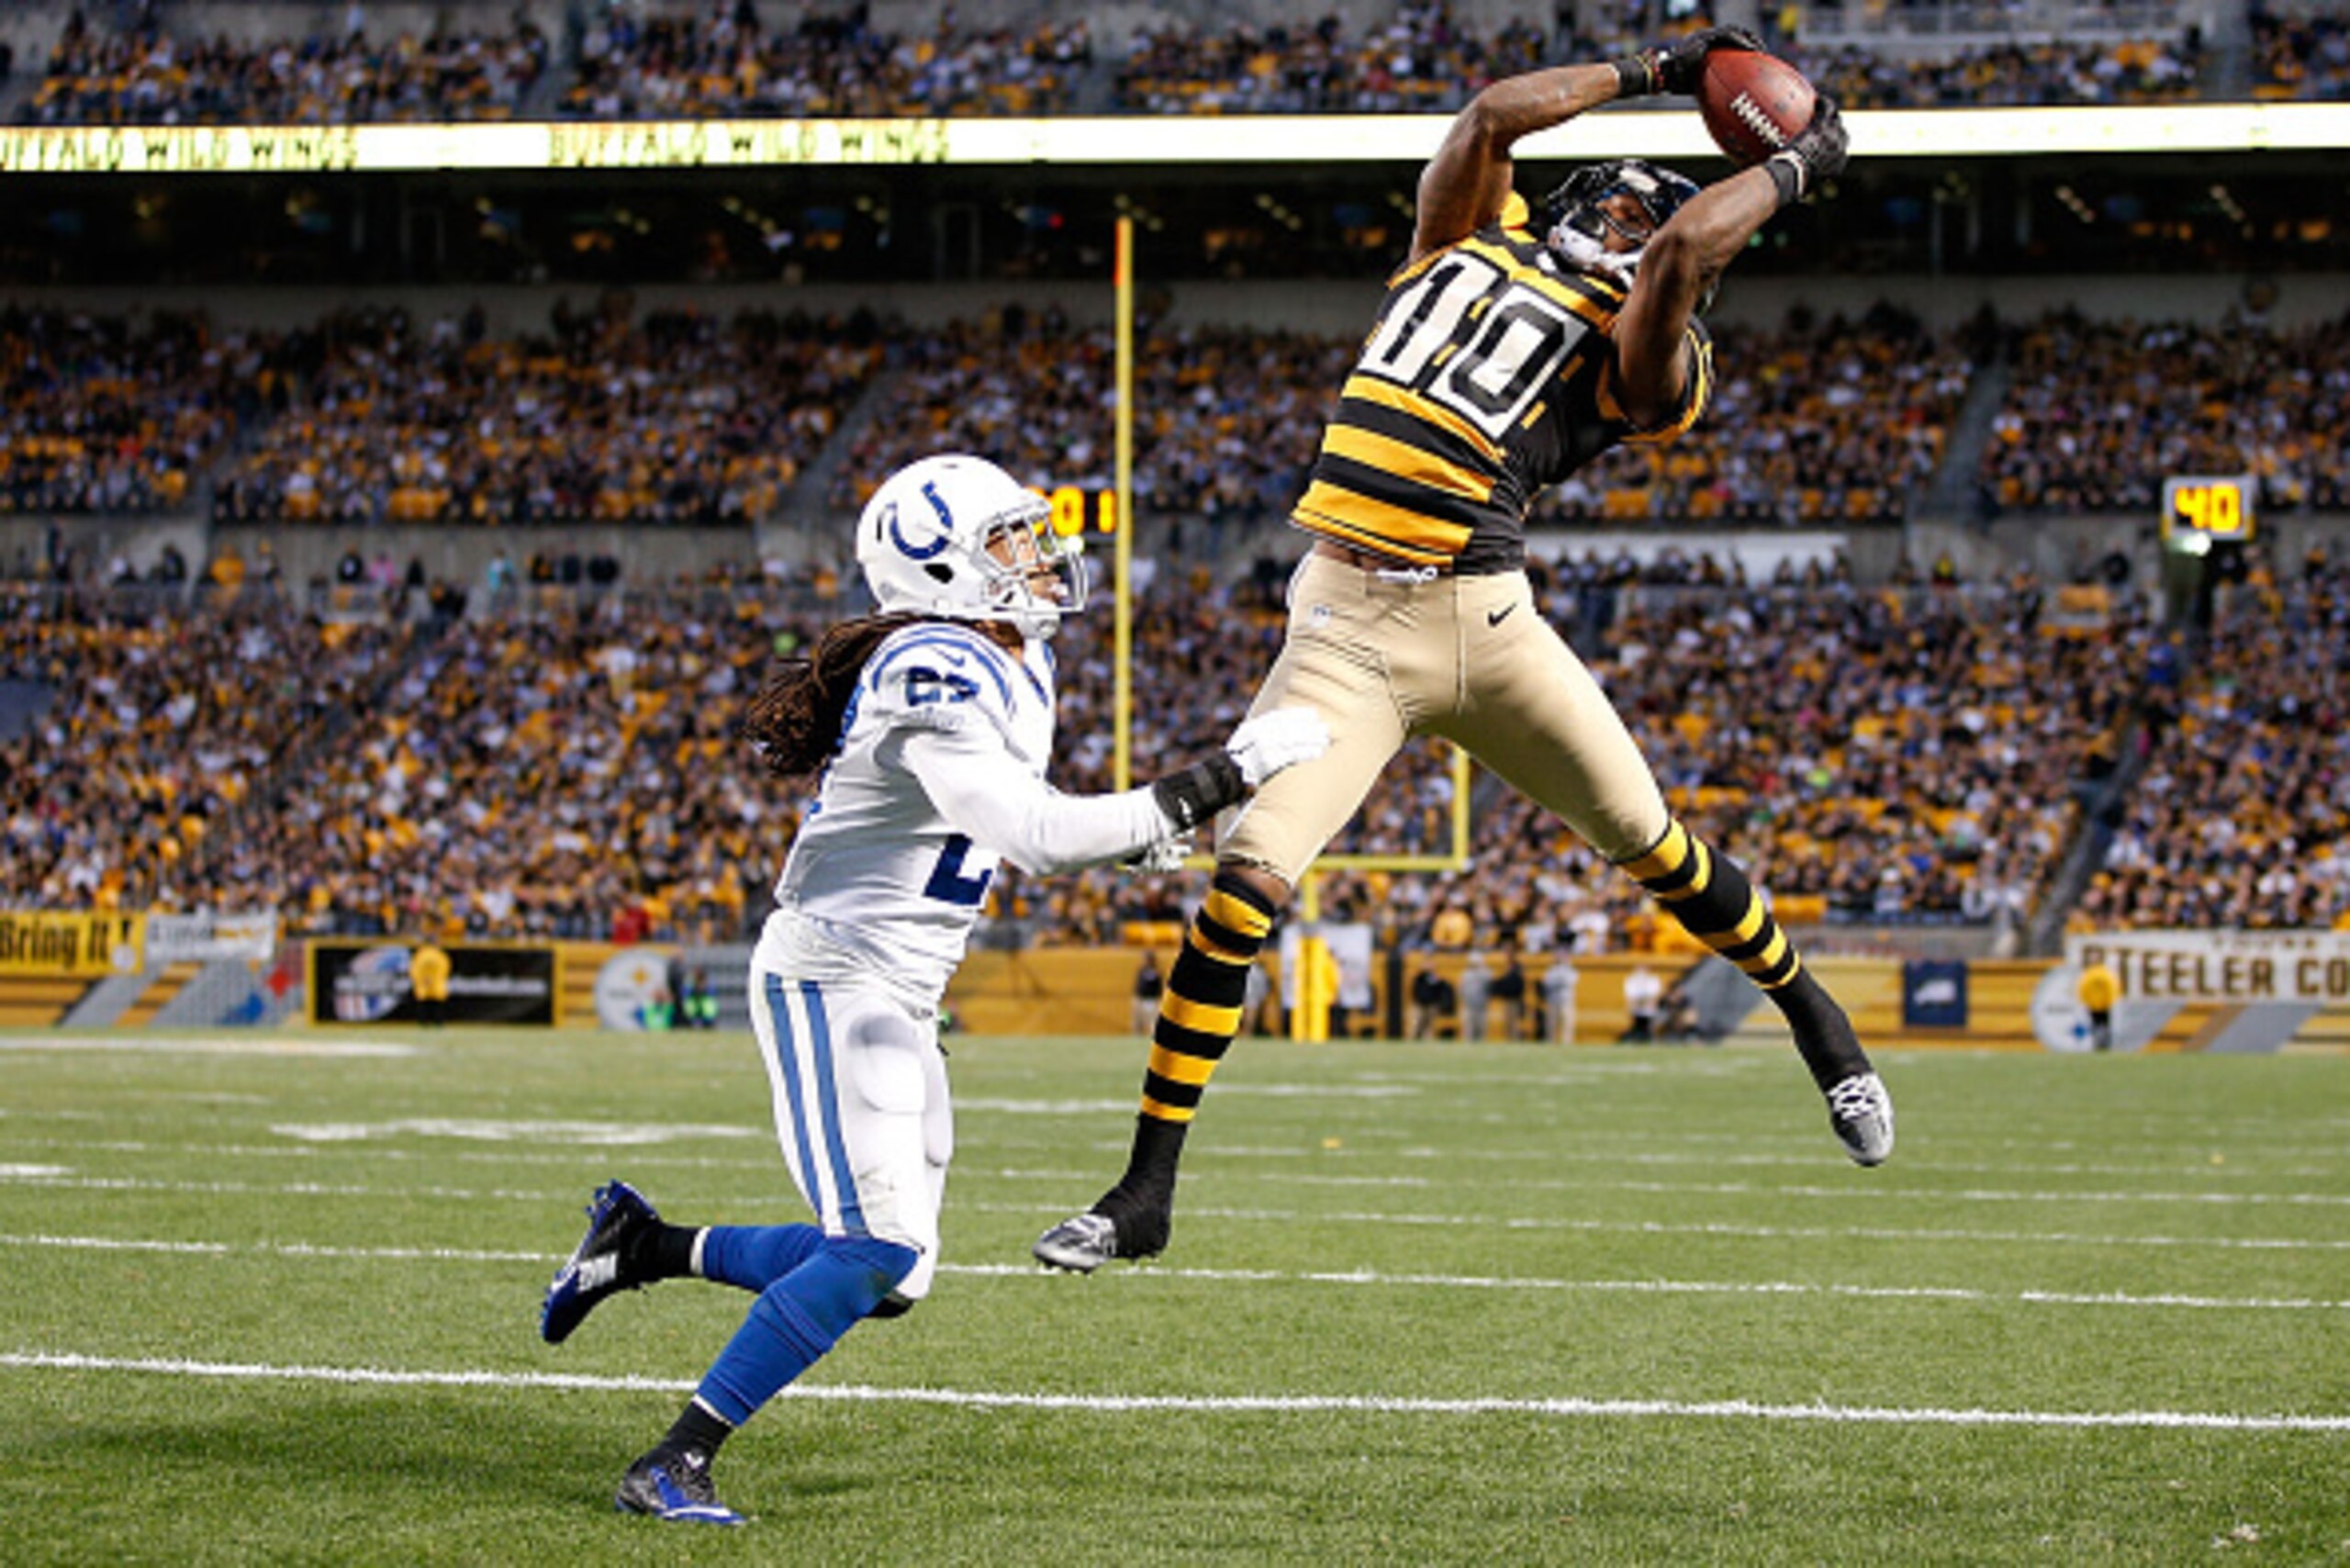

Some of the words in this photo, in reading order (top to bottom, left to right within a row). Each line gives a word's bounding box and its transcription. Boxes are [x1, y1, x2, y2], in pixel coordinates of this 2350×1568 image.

[143, 125, 228, 171] WILD
[249, 124, 356, 171] WINGS
[549, 120, 707, 168] BUFFALO
[730, 119, 817, 165] WILD
[839, 118, 948, 164] WINGS
[1358, 249, 1590, 441] 10
[2175, 483, 2242, 532] 40
